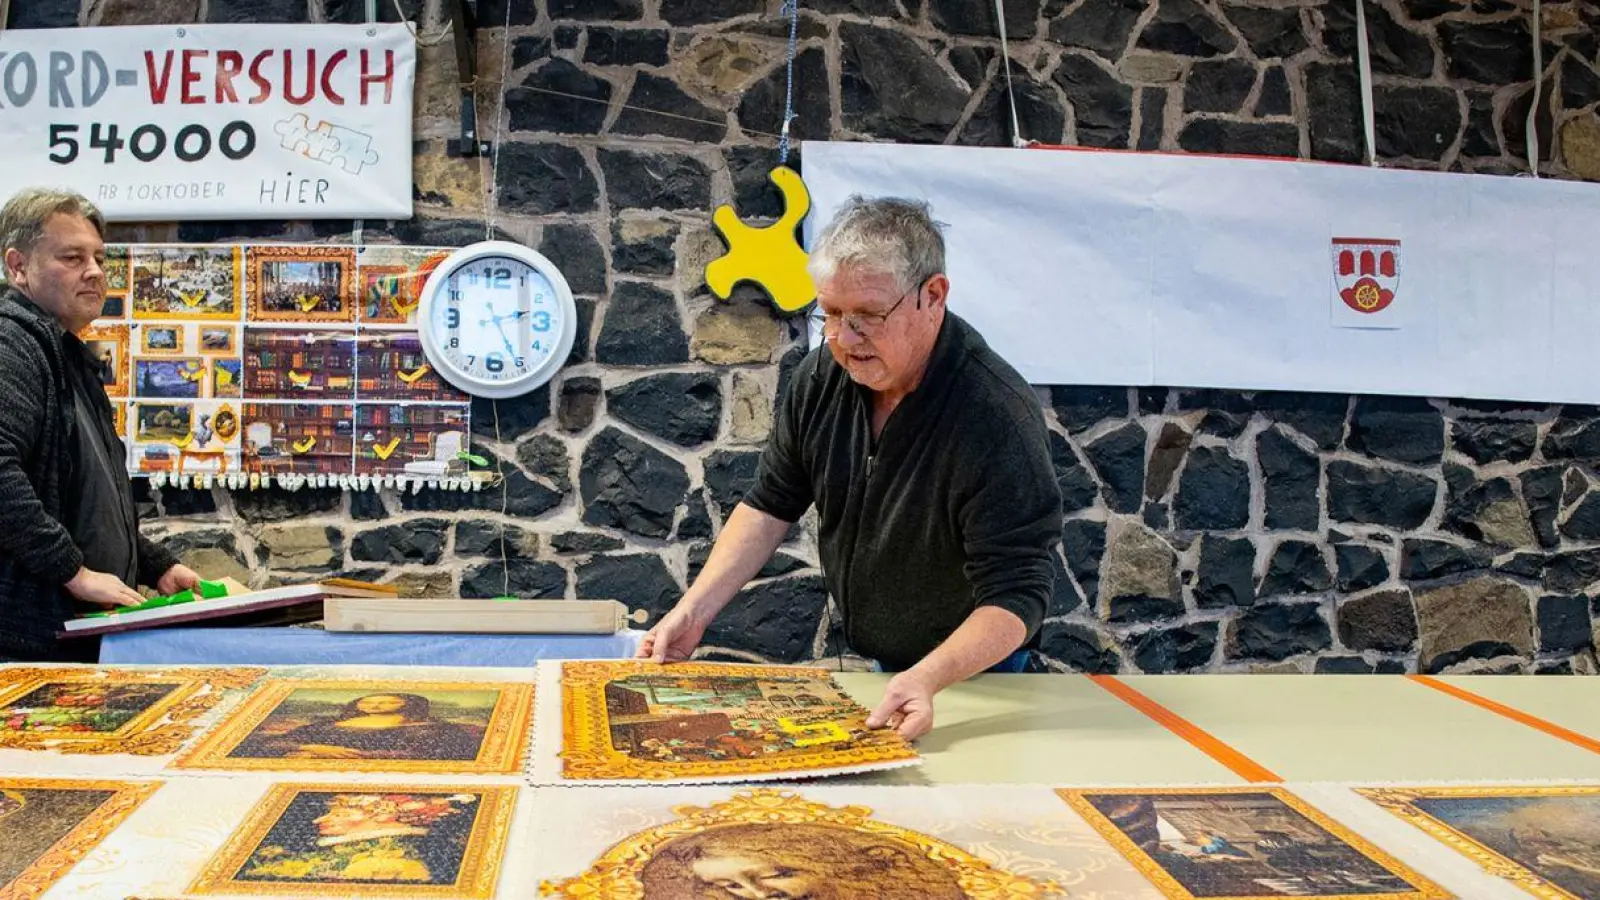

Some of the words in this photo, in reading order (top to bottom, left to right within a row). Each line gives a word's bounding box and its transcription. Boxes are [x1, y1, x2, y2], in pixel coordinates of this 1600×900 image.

[0, 49, 394, 109] ORD-VERSUCH
[49, 120, 256, 164] 54000
[484, 267, 512, 289] 12
[519, 276, 524, 287] 1
[532, 310, 551, 333] 3
[450, 336, 460, 349] 8
[532, 340, 541, 351] 4
[467, 355, 476, 366] 7
[485, 352, 504, 373] 6
